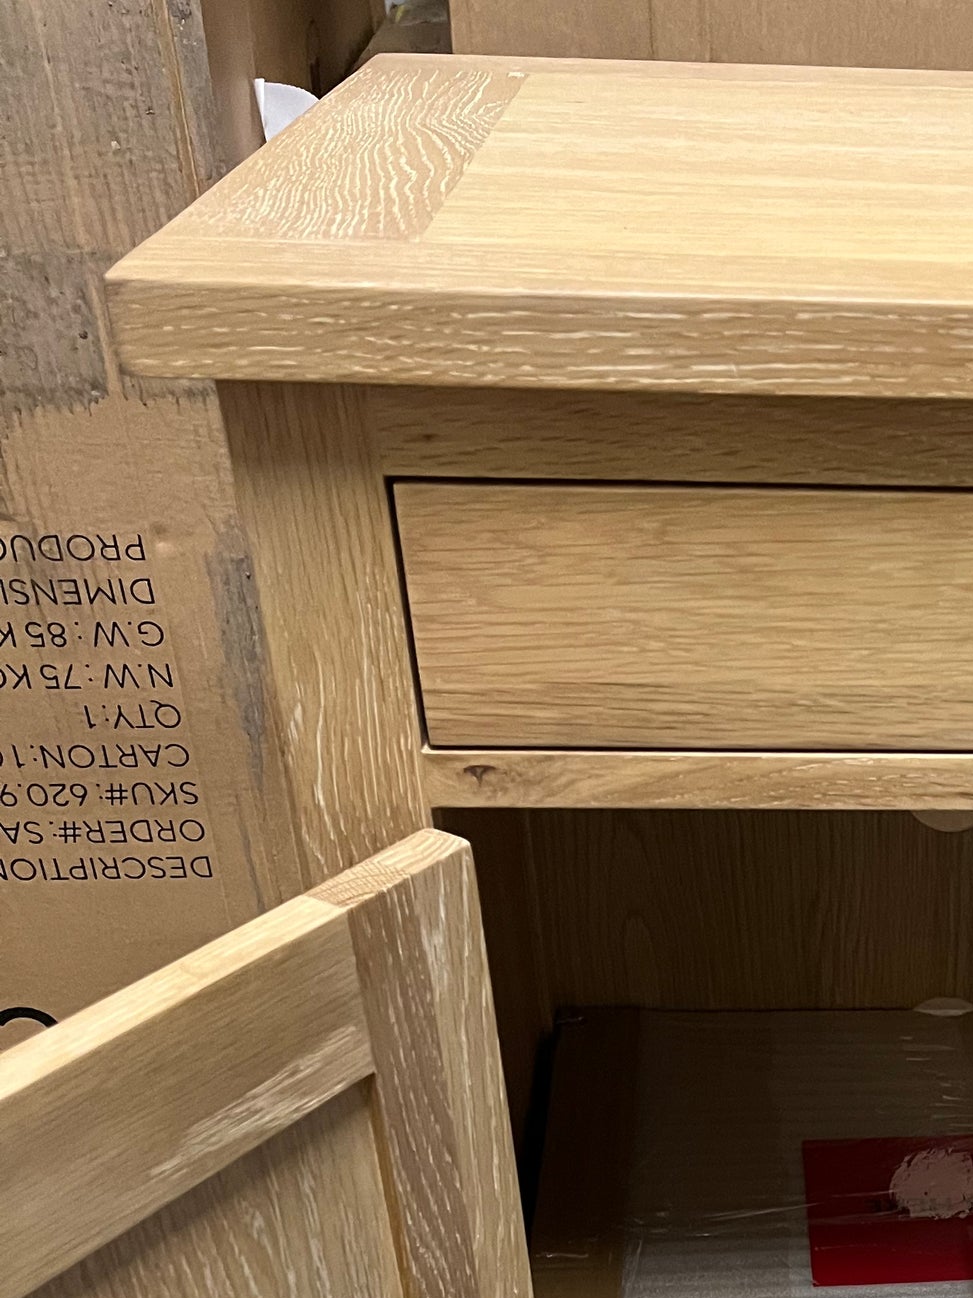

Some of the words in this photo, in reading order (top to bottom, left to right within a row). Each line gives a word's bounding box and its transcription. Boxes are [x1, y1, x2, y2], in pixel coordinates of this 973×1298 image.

[0, 534, 147, 562] PRODU
[24, 621, 68, 648] 85
[0, 663, 32, 690] K
[39, 663, 82, 690] 75
